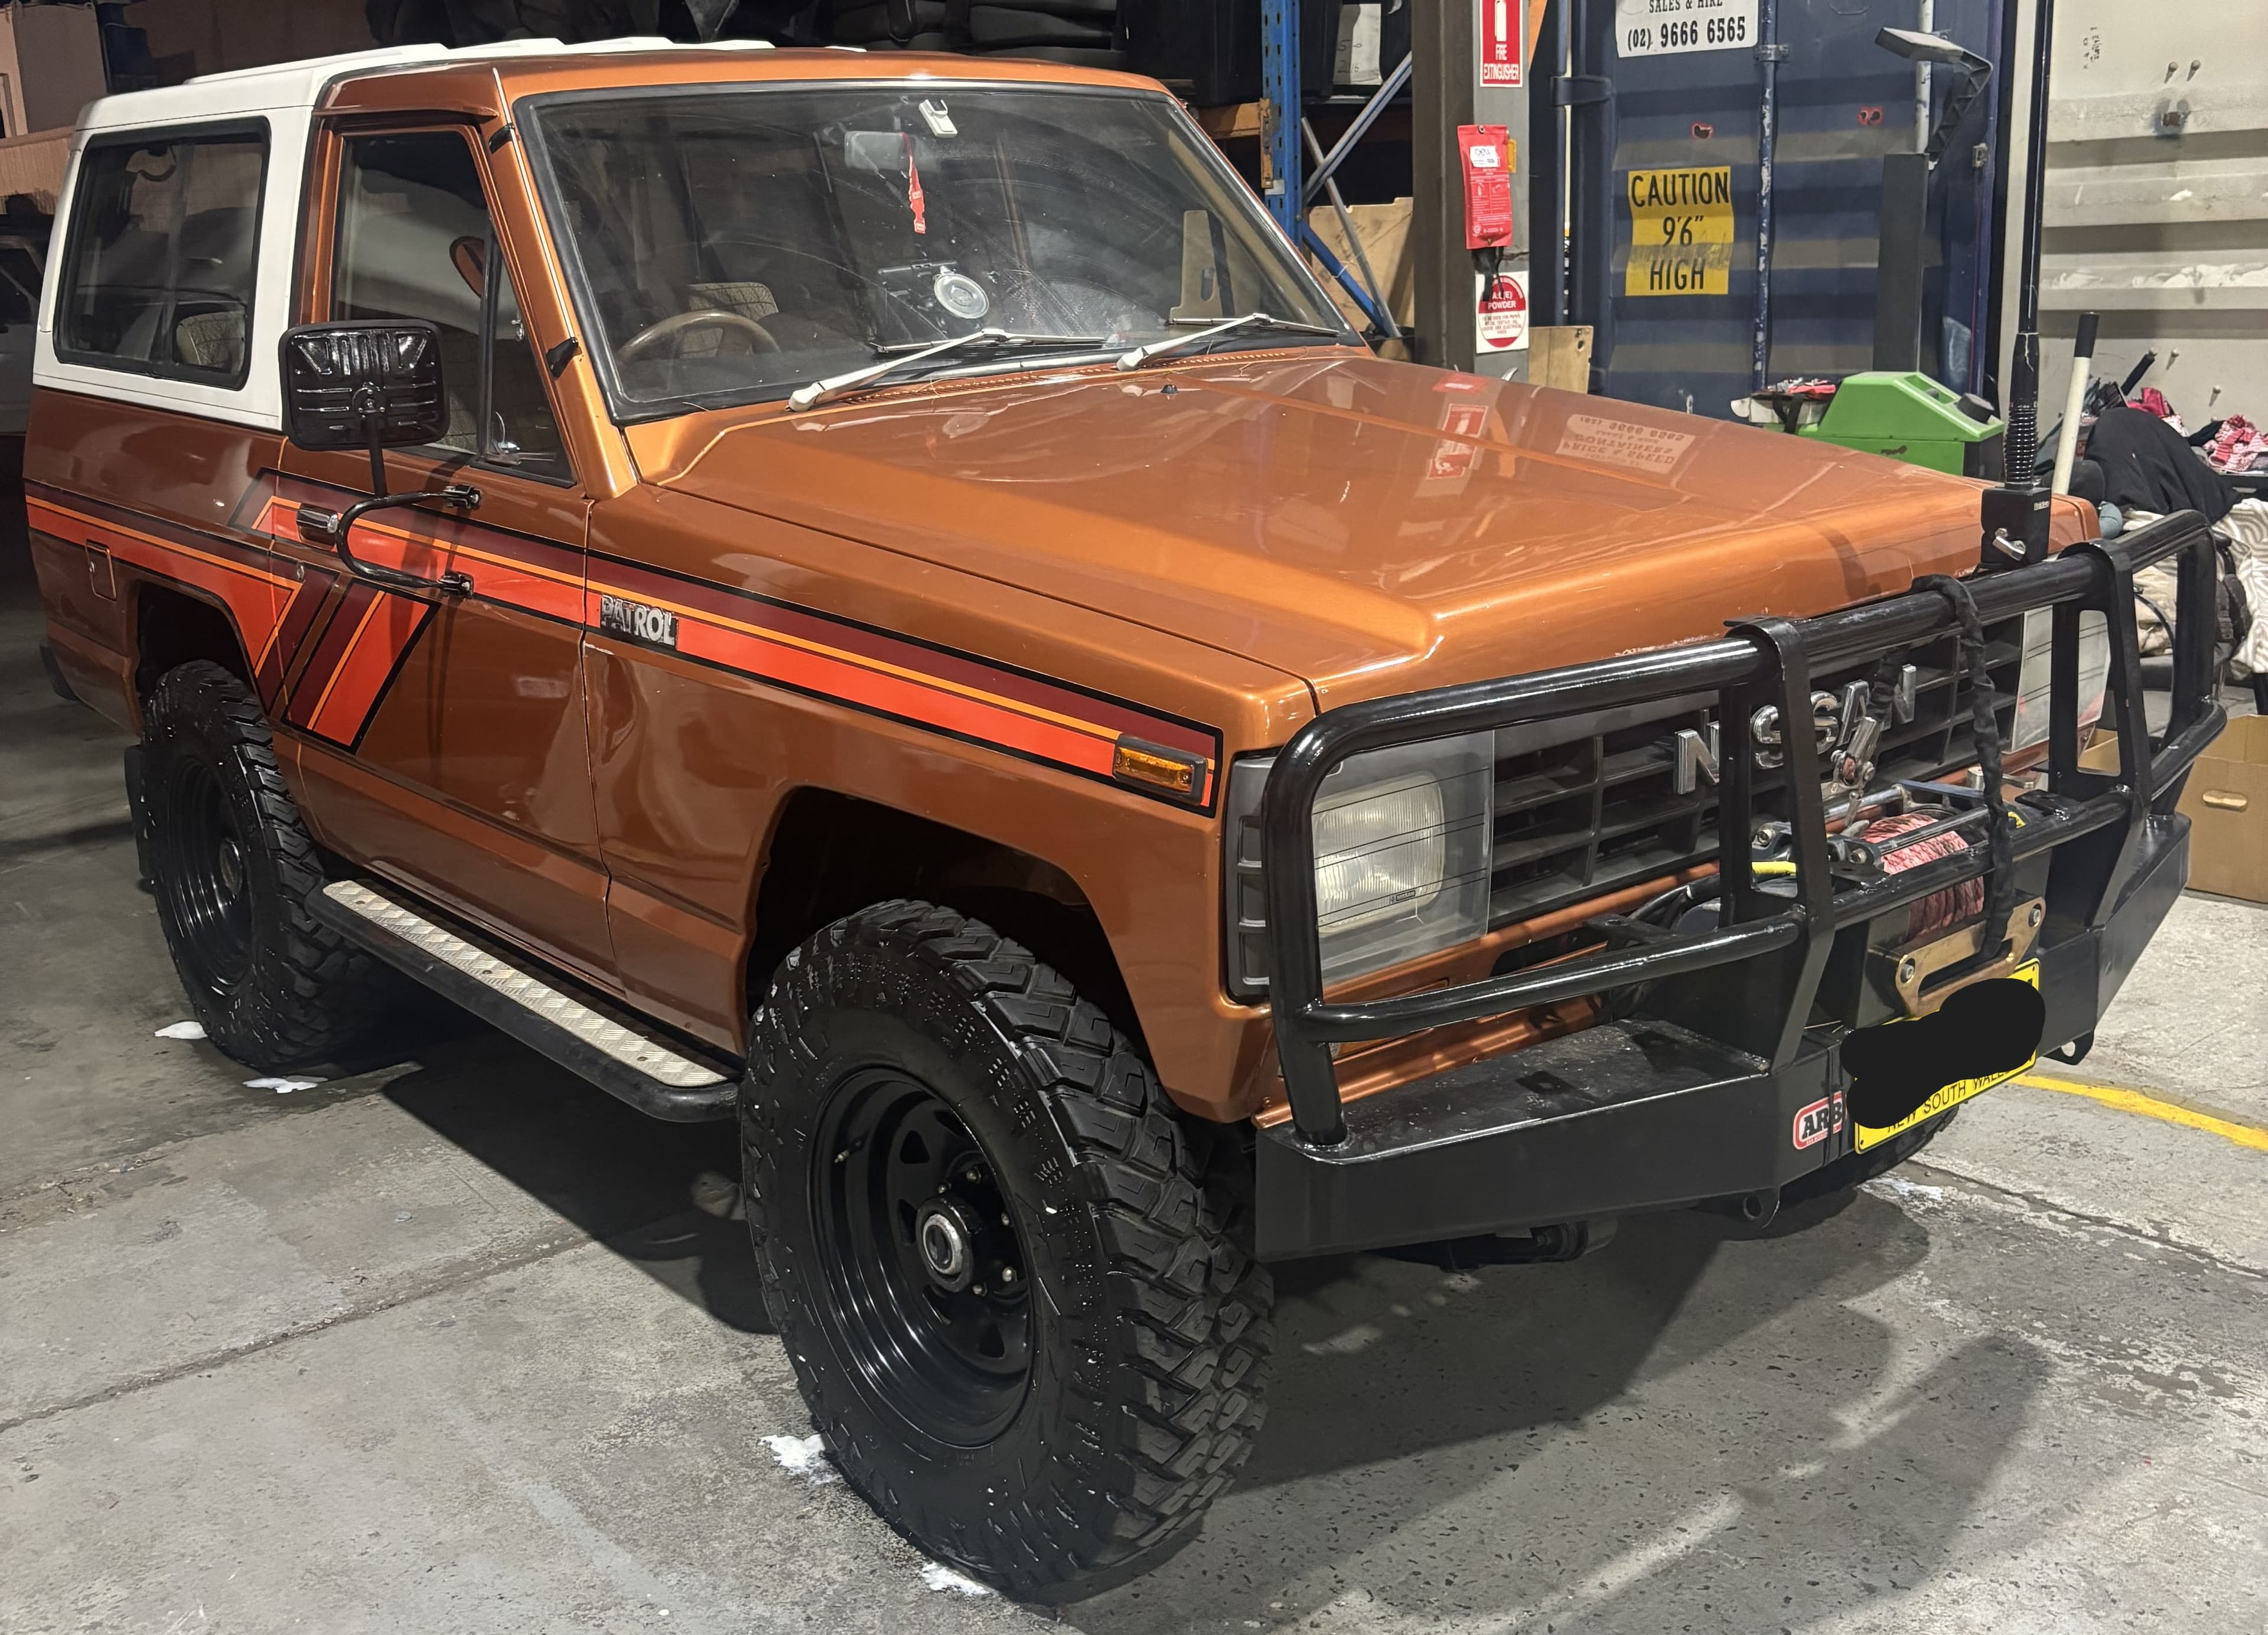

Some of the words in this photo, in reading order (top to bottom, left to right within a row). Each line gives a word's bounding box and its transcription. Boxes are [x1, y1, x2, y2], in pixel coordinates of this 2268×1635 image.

[1649, 0, 1680, 13] SALES
[1686, 0, 1692, 9] &
[1628, 28, 1651, 51] (02)
[1660, 21, 1698, 47] 9666
[1707, 16, 1745, 43] 6565
[1495, 44, 1507, 60] FIRE
[1483, 63, 1519, 80] EXTINGUISHER
[1631, 172, 1729, 207] CAUTION
[1650, 257, 1706, 290] HIGH
[1488, 301, 1516, 309] POWDER
[601, 595, 676, 646] PATROL
[1675, 663, 1917, 795] NSSAN
[1923, 1081, 1966, 1114] SOUTH
[1802, 1101, 1843, 1140] ARB
